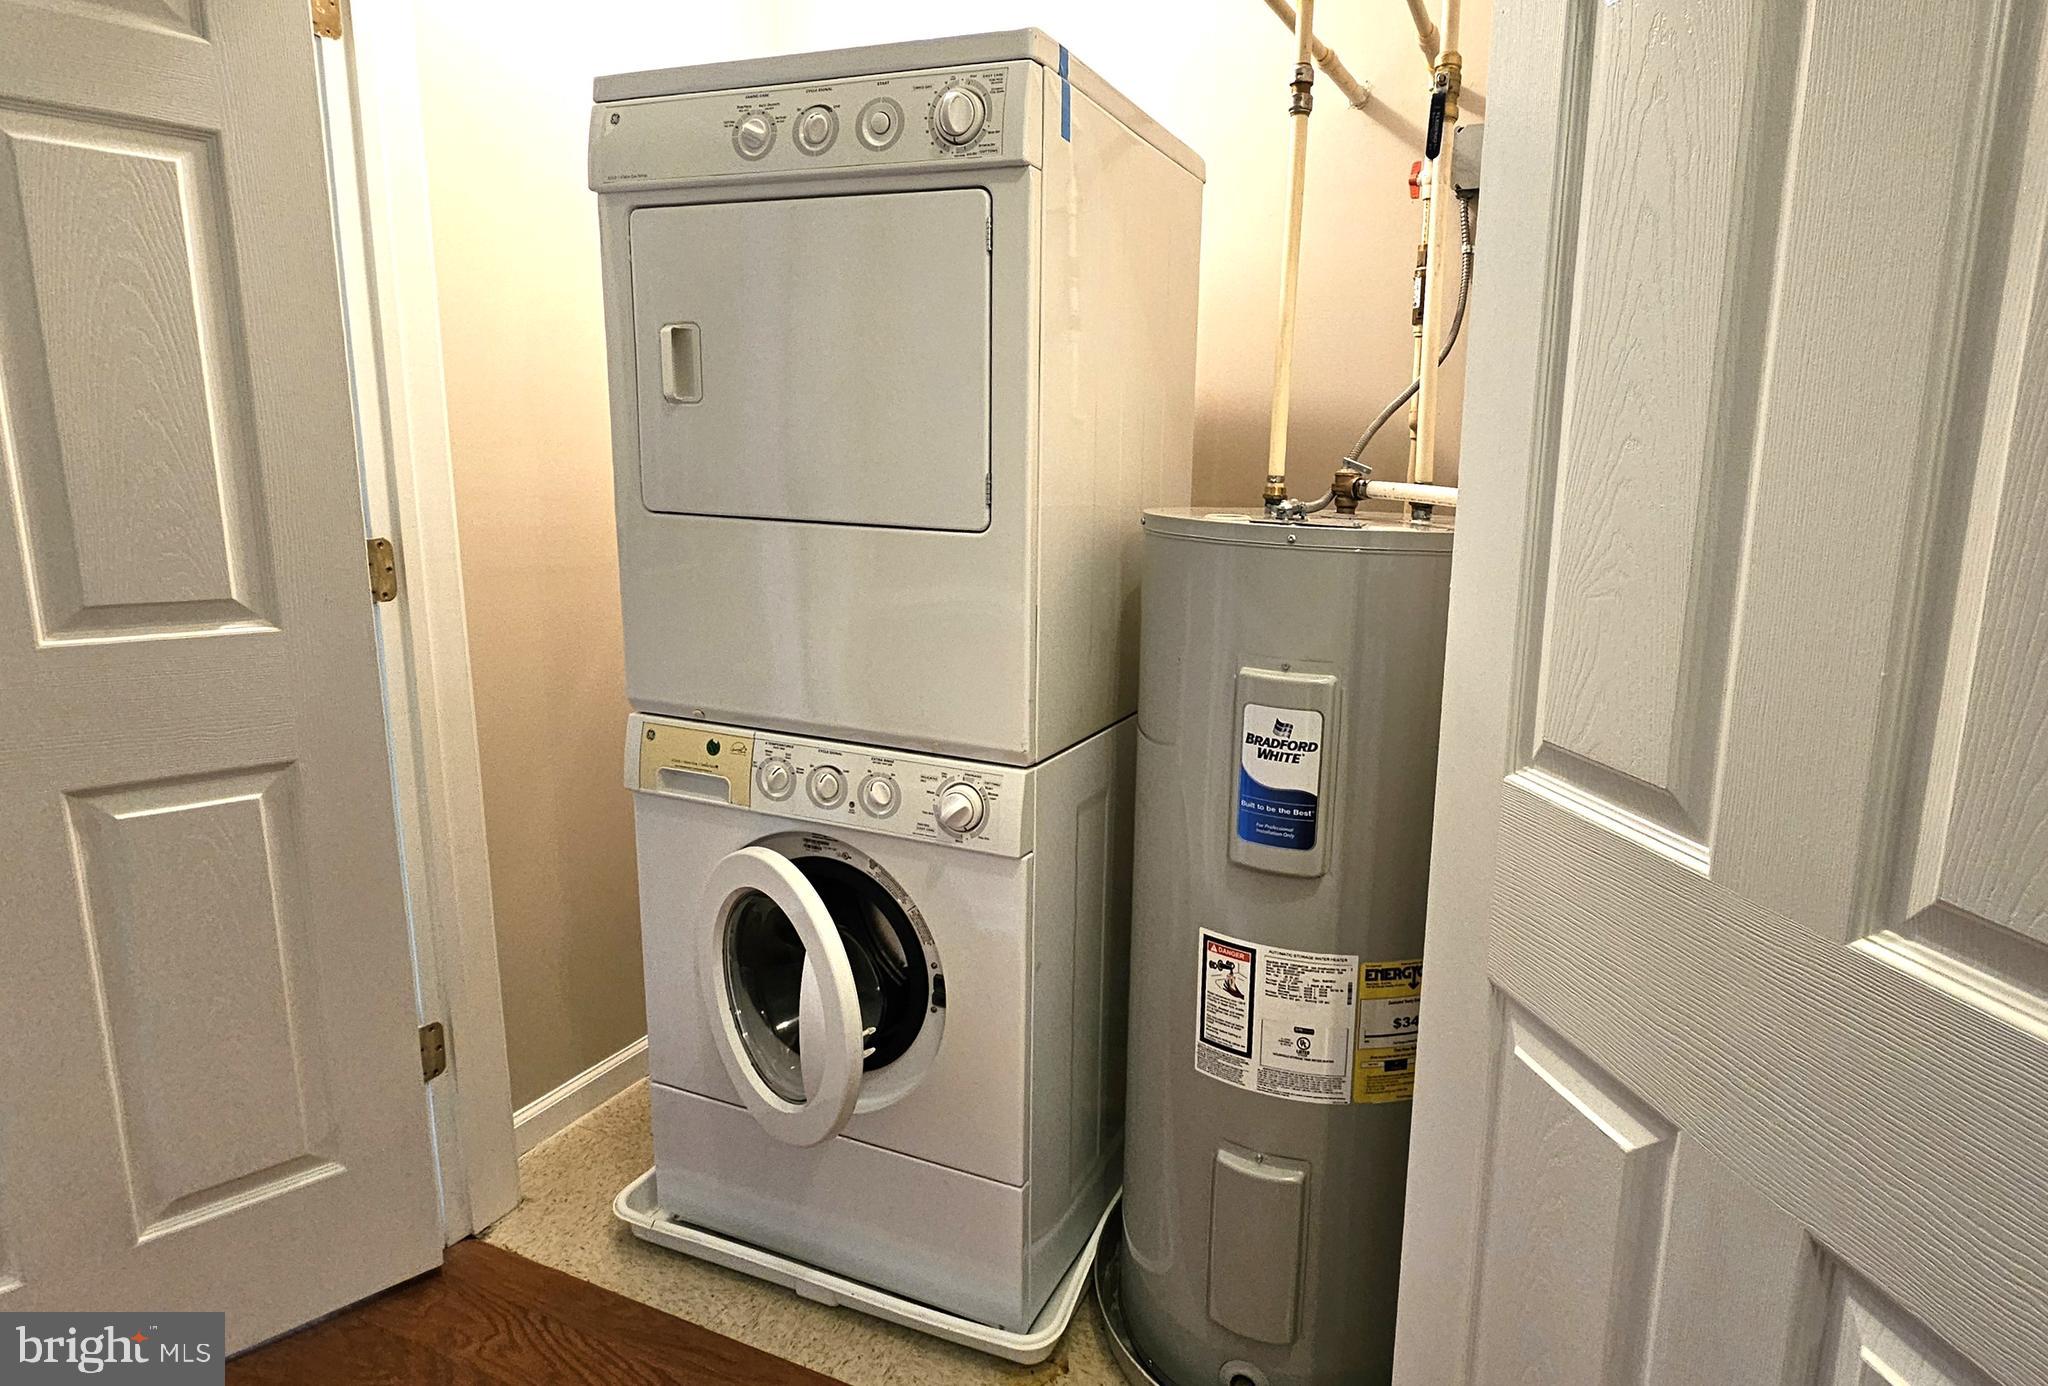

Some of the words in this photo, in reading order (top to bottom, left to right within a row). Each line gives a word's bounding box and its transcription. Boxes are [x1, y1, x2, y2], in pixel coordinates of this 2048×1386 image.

[1245, 732, 1318, 752] BRADFORD
[1257, 747, 1301, 763] WHITE
[1241, 800, 1255, 809] Built
[1257, 803, 1264, 811] to
[1266, 804, 1277, 813] be
[1278, 807, 1291, 815] the
[1293, 808, 1312, 817] Best
[1218, 946, 1245, 960] DANGER
